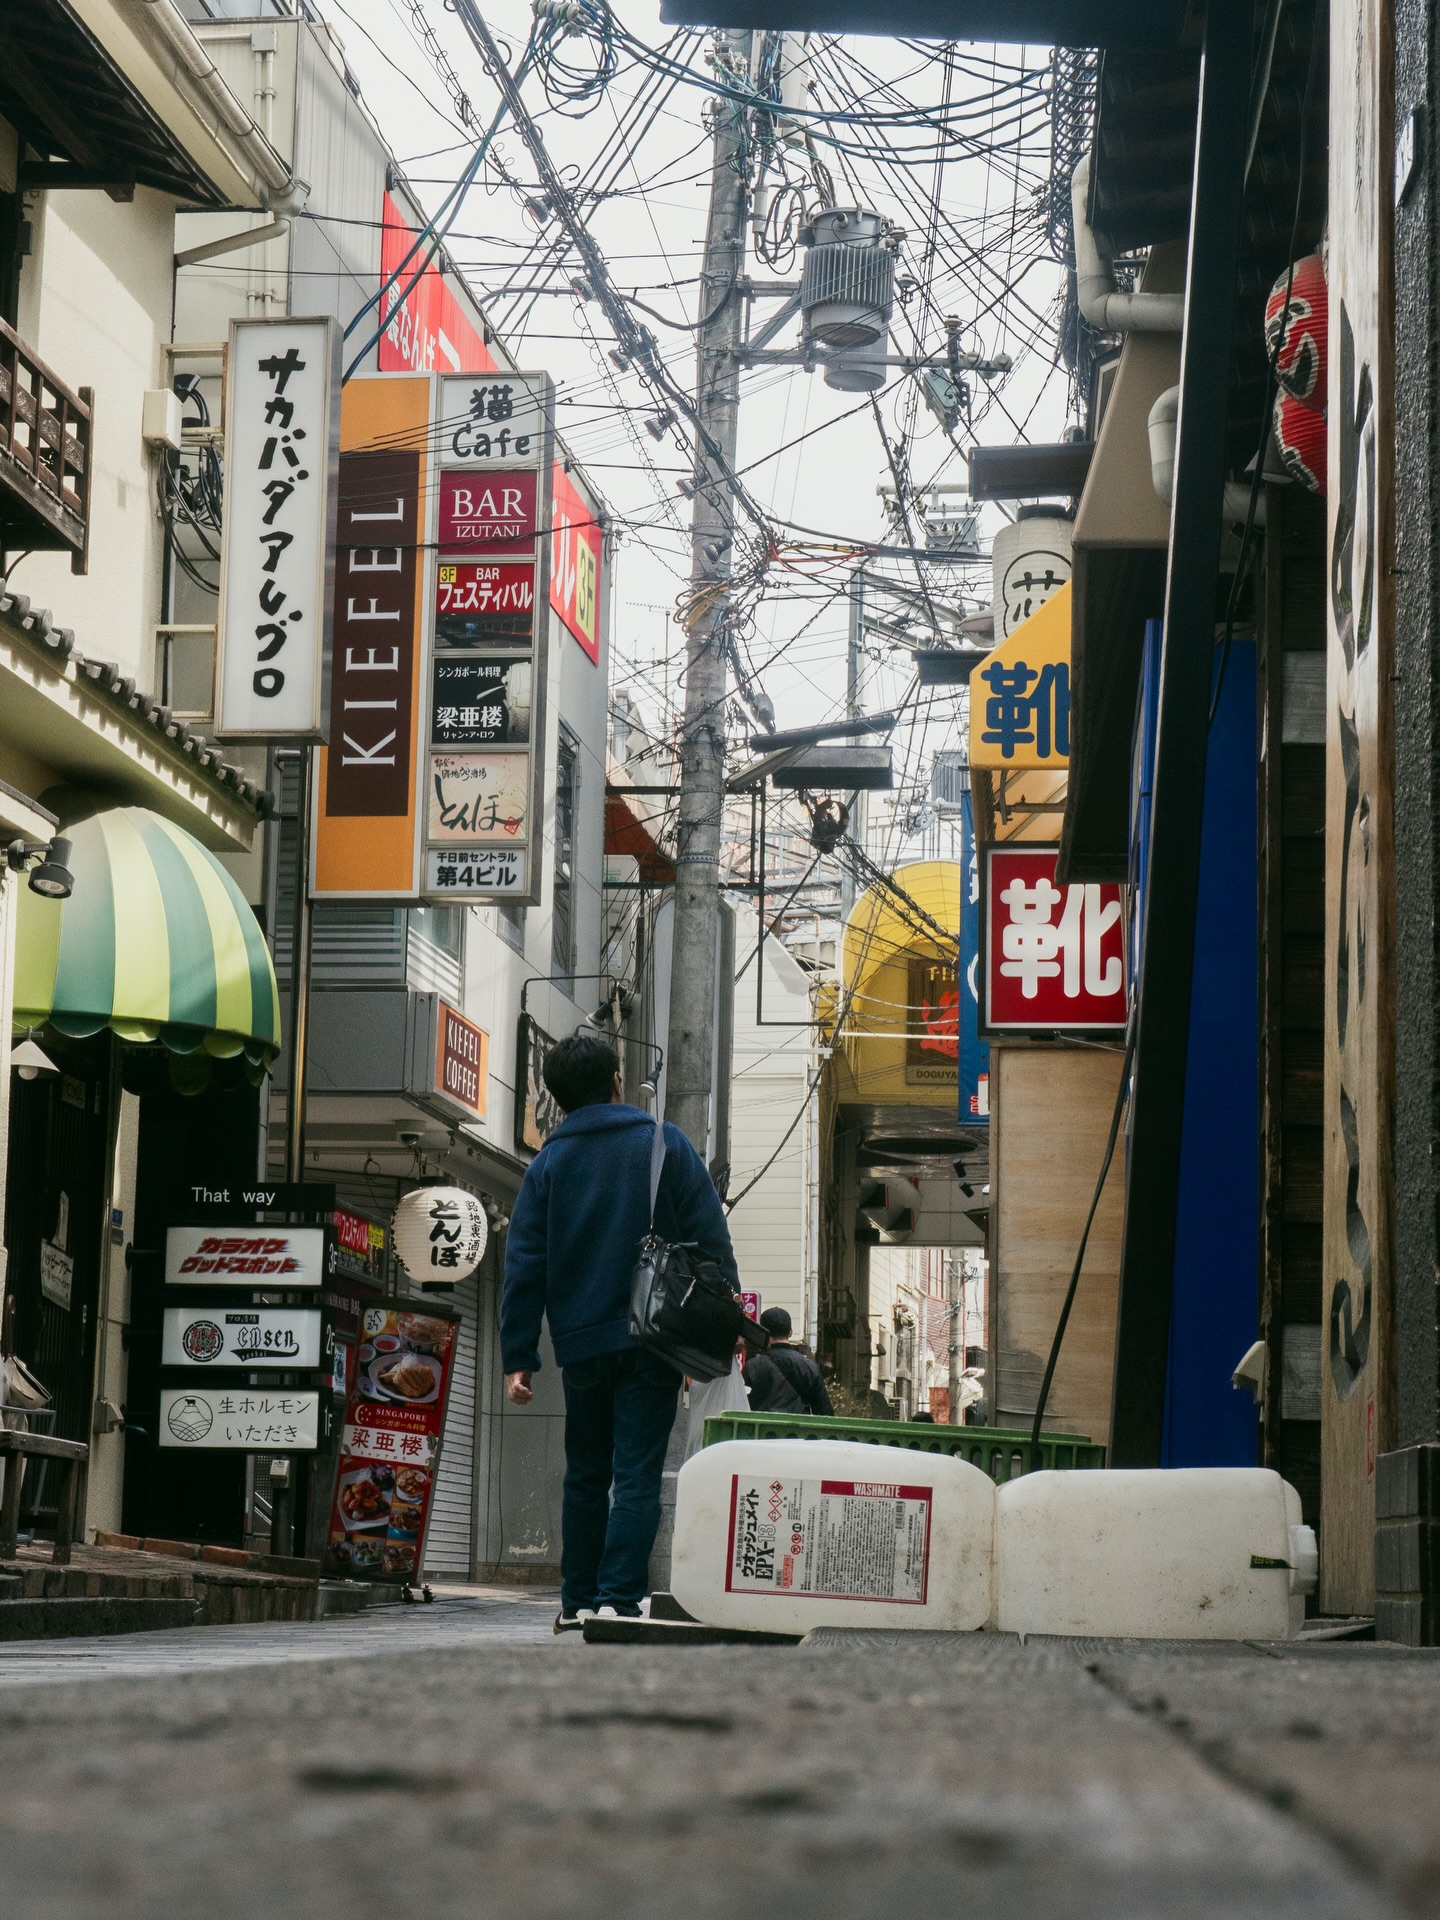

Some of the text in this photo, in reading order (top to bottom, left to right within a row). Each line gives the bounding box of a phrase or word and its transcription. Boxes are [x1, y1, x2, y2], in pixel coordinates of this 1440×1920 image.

[469, 384, 514, 423] 猫
[452, 423, 531, 458] Cafe
[452, 488, 527, 518] BAR
[456, 525, 521, 538] IZUTANI
[441, 568, 455, 582] 3F
[476, 567, 500, 580] BAR
[578, 545, 595, 628] 3F
[439, 582, 533, 611] フェスティバル
[342, 497, 404, 767] KIEFEL
[438, 666, 501, 678] シンガポール料理
[436, 706, 503, 728] 梁亜楼
[437, 852, 517, 863] 千日前セントラル
[436, 866, 517, 887] 第4ビル
[1000, 878, 1122, 999] 靴
[447, 1017, 479, 1066] KIEFEL
[446, 1056, 477, 1102] COFFEE
[191, 1187, 276, 1206] That way
[196, 1238, 289, 1254] カラオケ
[429, 1200, 464, 1268] とんぼ
[329, 1242, 338, 1274] 3F
[326, 1324, 335, 1355] 2F
[218, 1396, 312, 1415] 生ホルモン
[376, 1408, 427, 1422] SINGAPORE
[226, 1425, 298, 1443] いただき
[324, 1405, 333, 1437] 1F
[375, 1420, 426, 1431] シンガポール料理
[351, 1428, 423, 1456] 梁亜楼
[853, 1482, 900, 1498] WASHMATE
[755, 1524, 776, 1581] EPX-13
